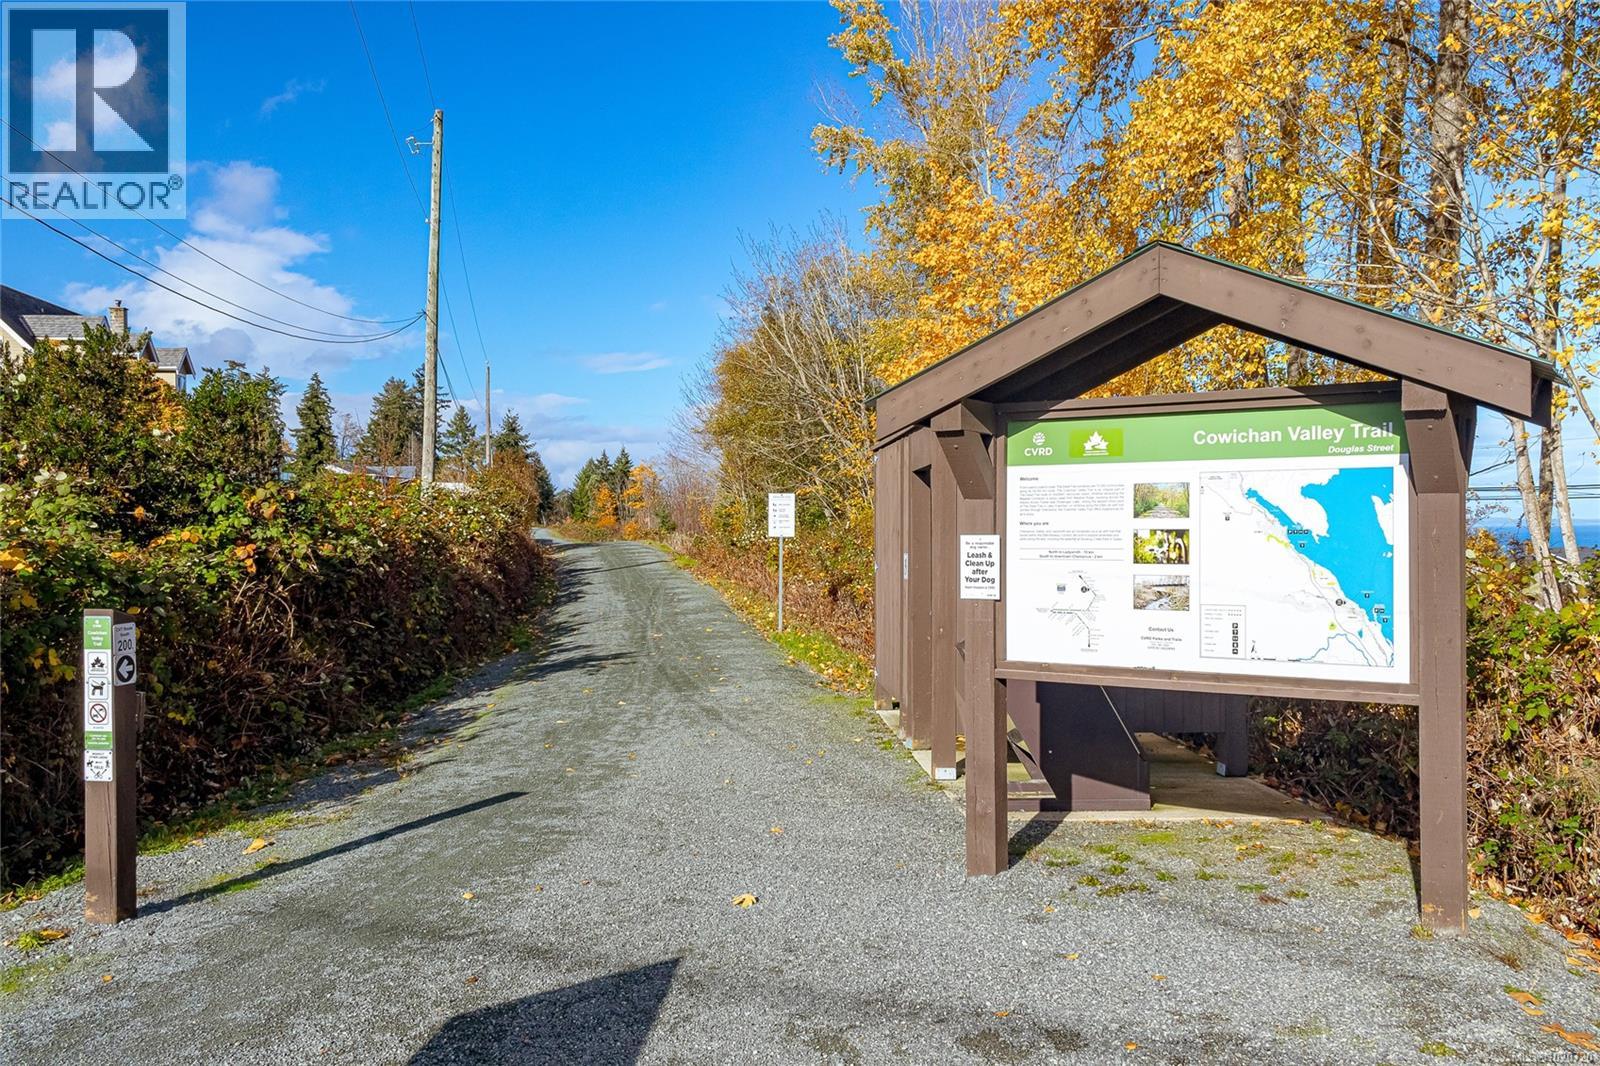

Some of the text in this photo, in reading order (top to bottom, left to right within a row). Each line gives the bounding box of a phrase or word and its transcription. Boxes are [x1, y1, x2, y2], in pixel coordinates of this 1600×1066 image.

[1193, 421, 1394, 445] Cowichan Valley Trail
[1024, 447, 1054, 457] CVRD
[1328, 443, 1395, 455] Douglas Street
